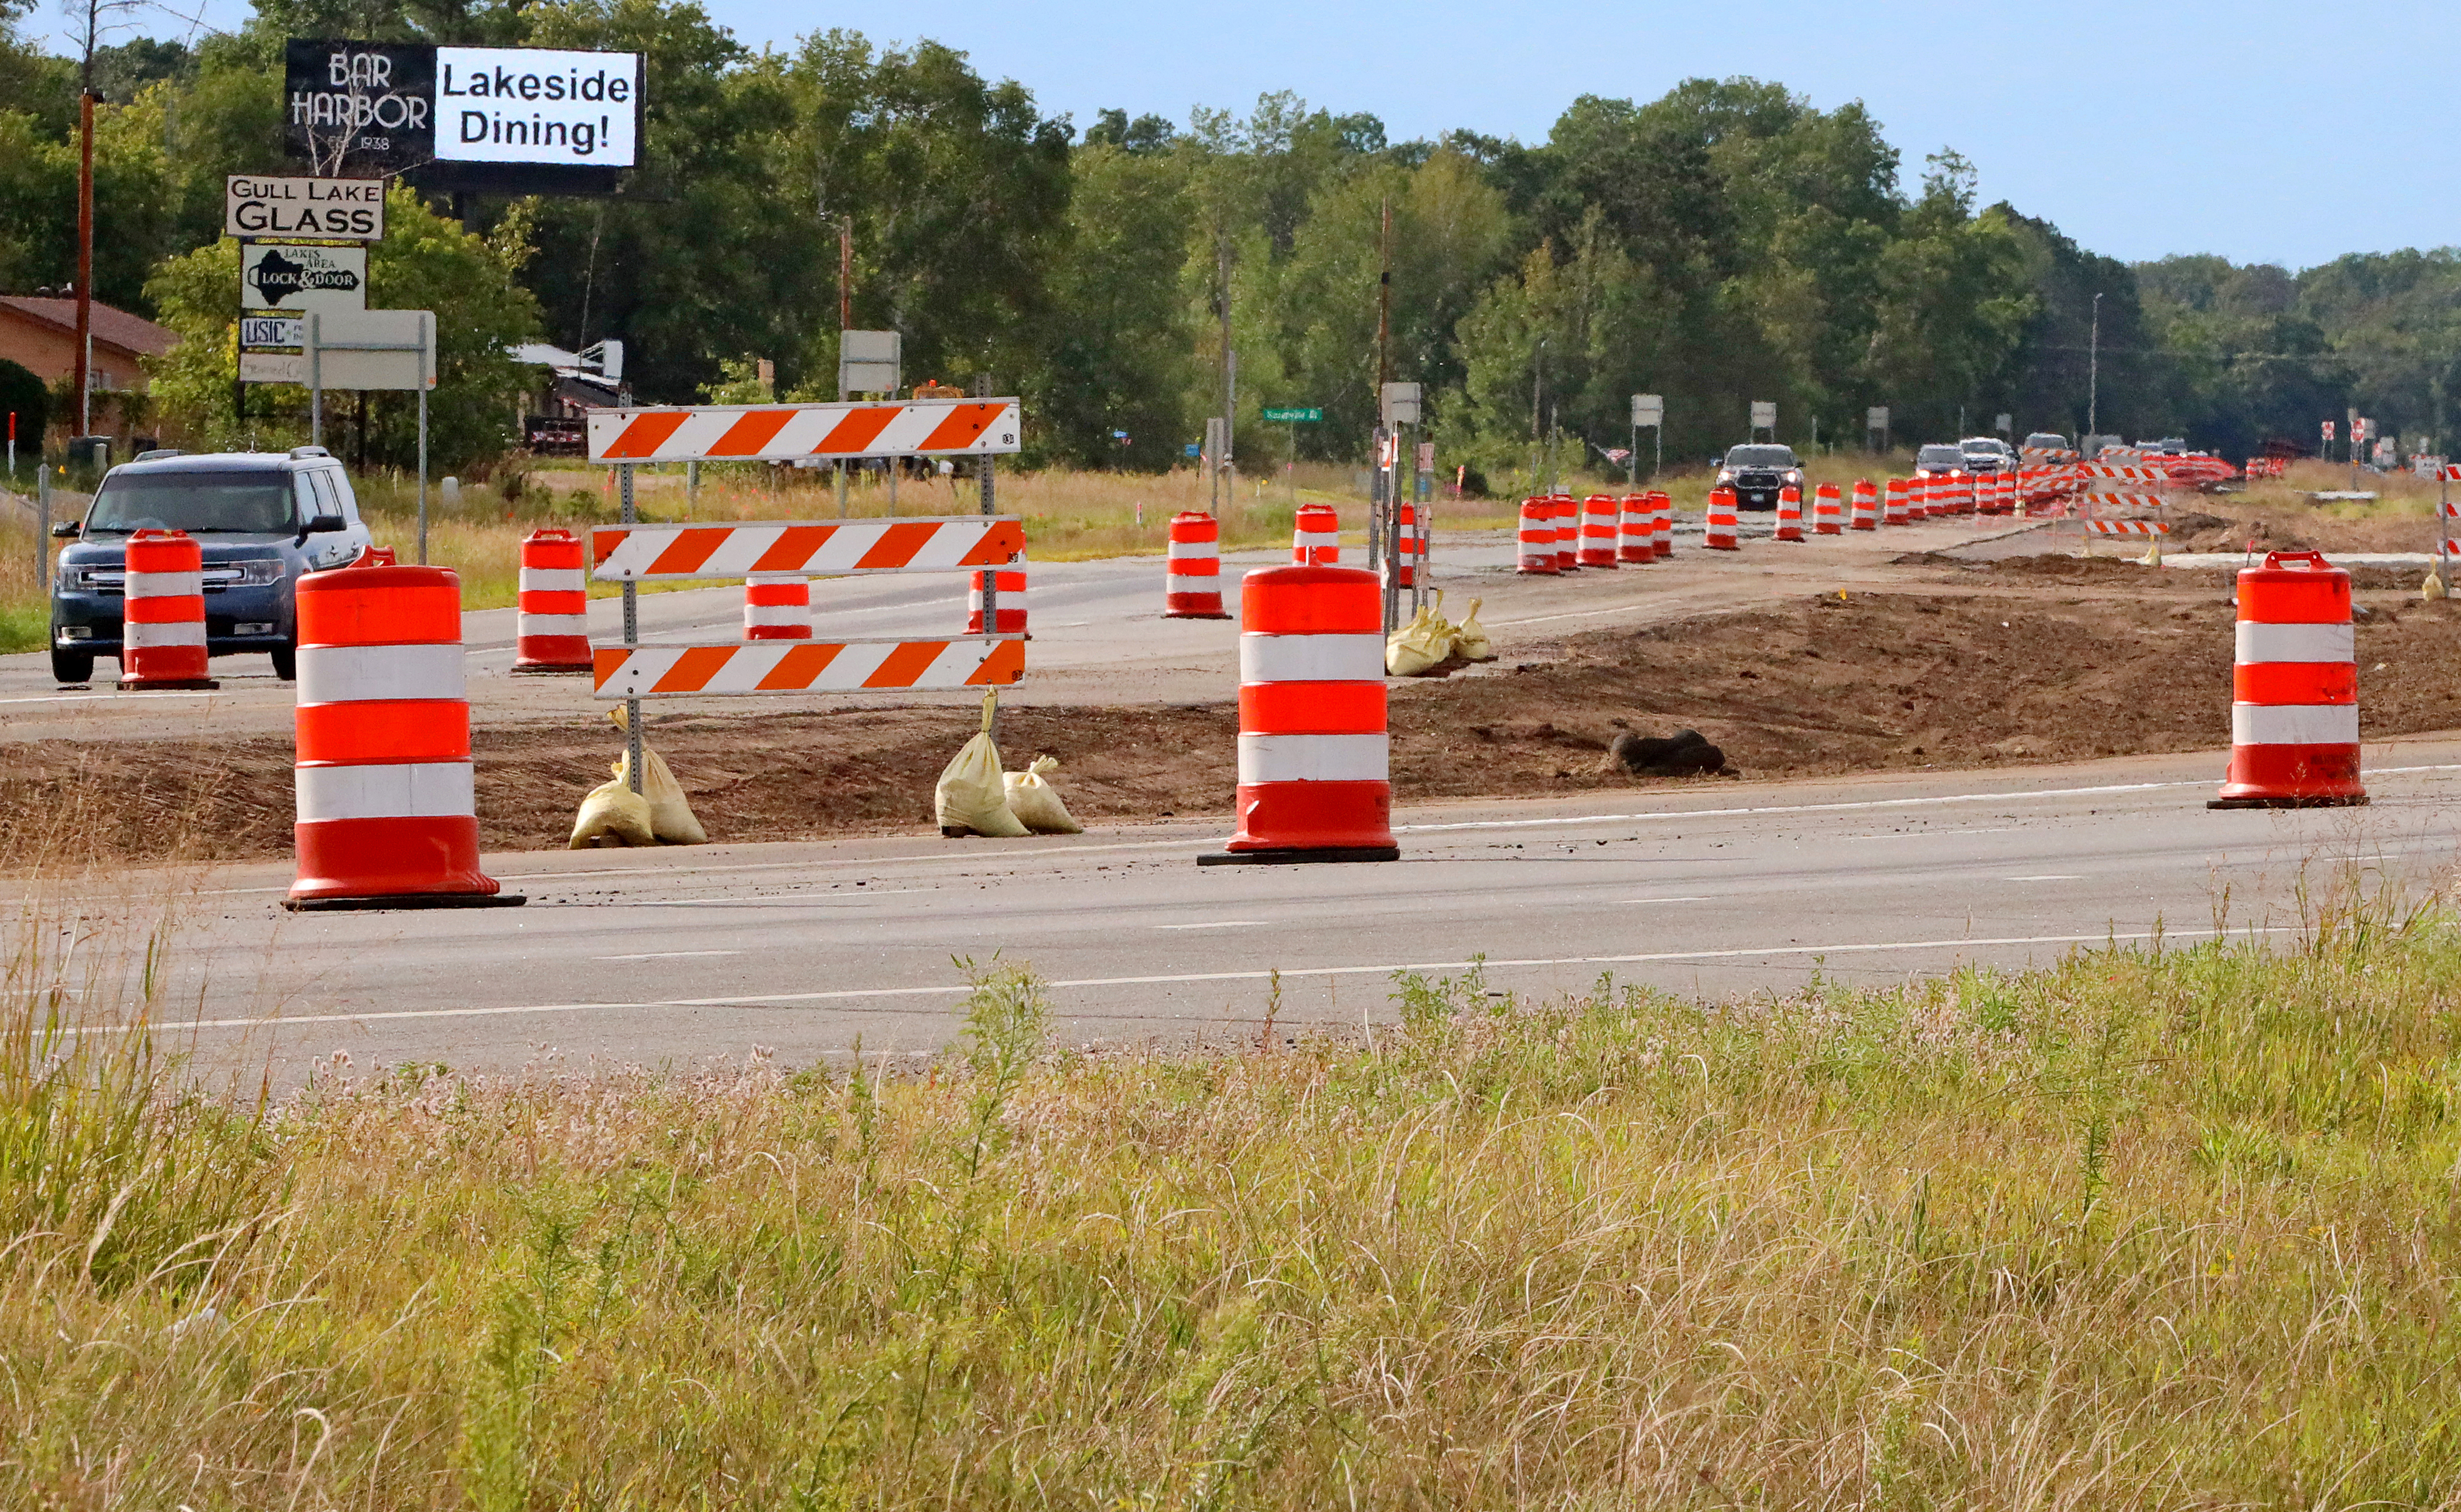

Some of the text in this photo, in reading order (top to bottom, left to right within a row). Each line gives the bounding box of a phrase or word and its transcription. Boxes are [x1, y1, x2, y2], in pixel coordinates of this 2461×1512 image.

[329, 53, 391, 87] BAR
[443, 63, 629, 103] Lakeside
[292, 91, 428, 129] HARBOR
[361, 137, 390, 150] 1938
[460, 110, 608, 156] Dining!
[231, 179, 380, 202] GULL LAKE
[235, 200, 374, 234] GLASS
[283, 248, 321, 259] LAKES
[306, 258, 336, 269] AREA
[262, 272, 298, 285] LOCK
[315, 273, 353, 286] DOOR
[246, 320, 286, 343] USIC
